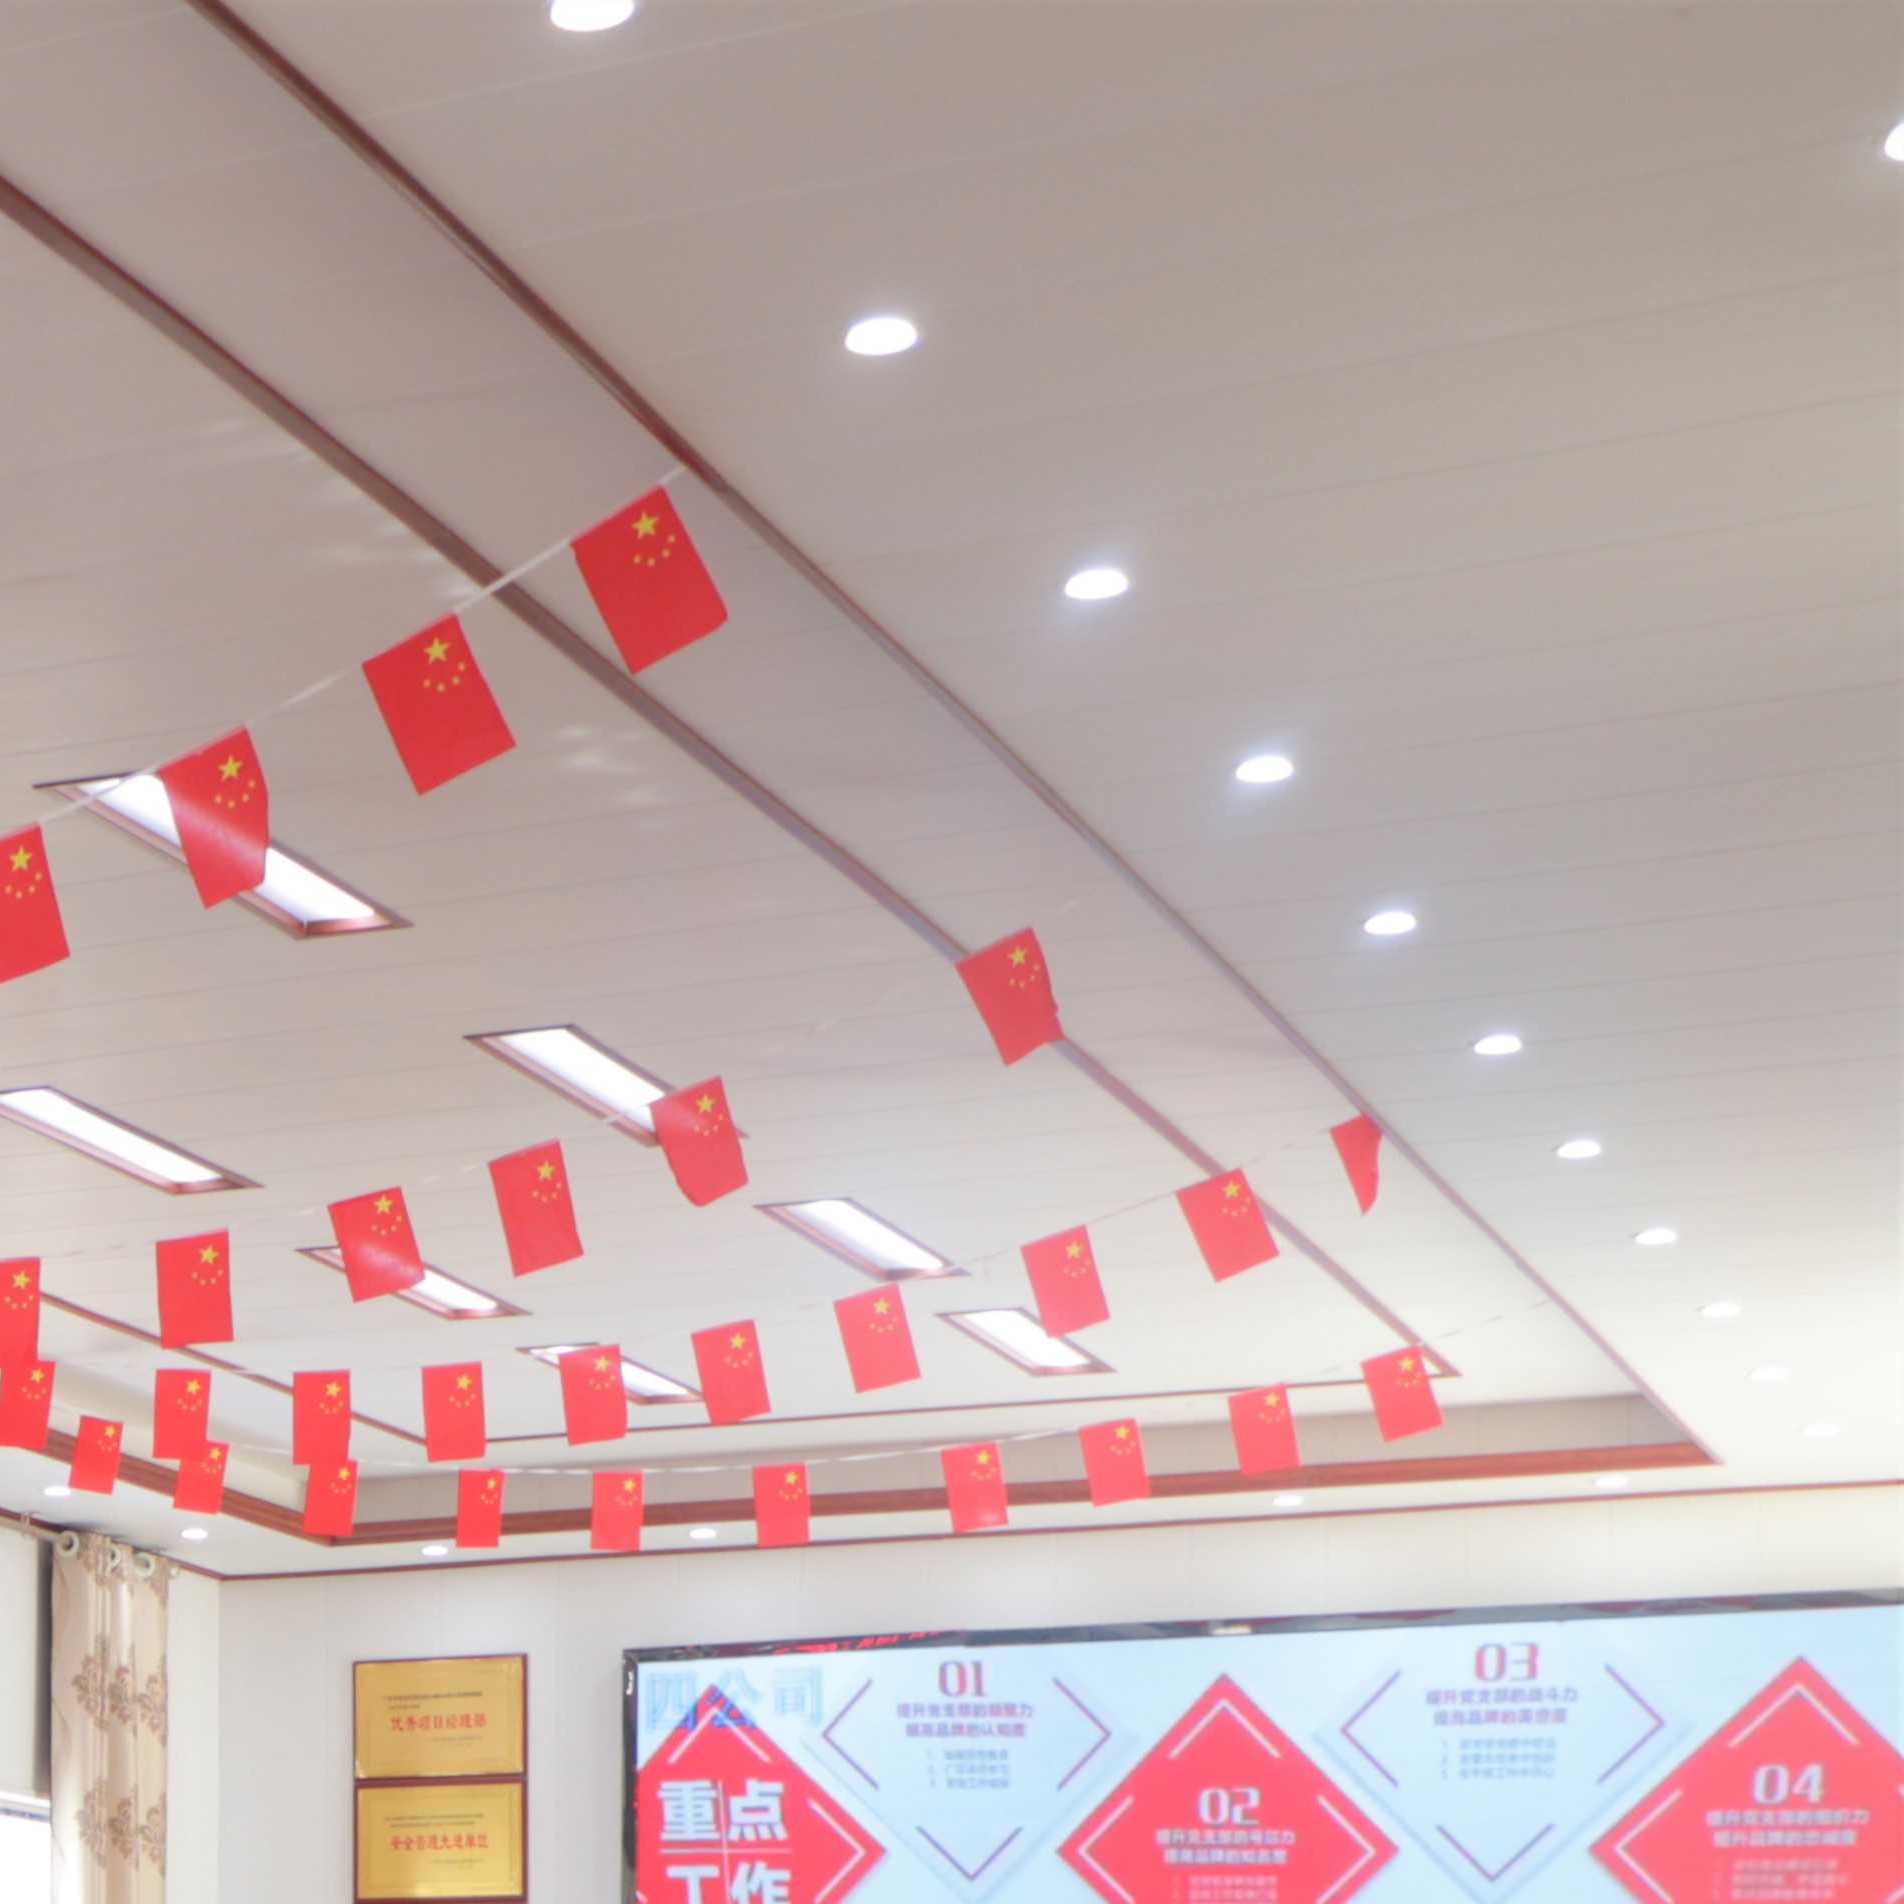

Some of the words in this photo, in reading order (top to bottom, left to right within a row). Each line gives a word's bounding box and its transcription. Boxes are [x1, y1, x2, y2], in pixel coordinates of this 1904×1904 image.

[938, 1659, 987, 1697] 01
[1475, 1642, 1539, 1682] 03
[1753, 1762, 1825, 1805] 04
[657, 1778, 789, 1841] 重点
[1198, 1787, 1262, 1826] 02
